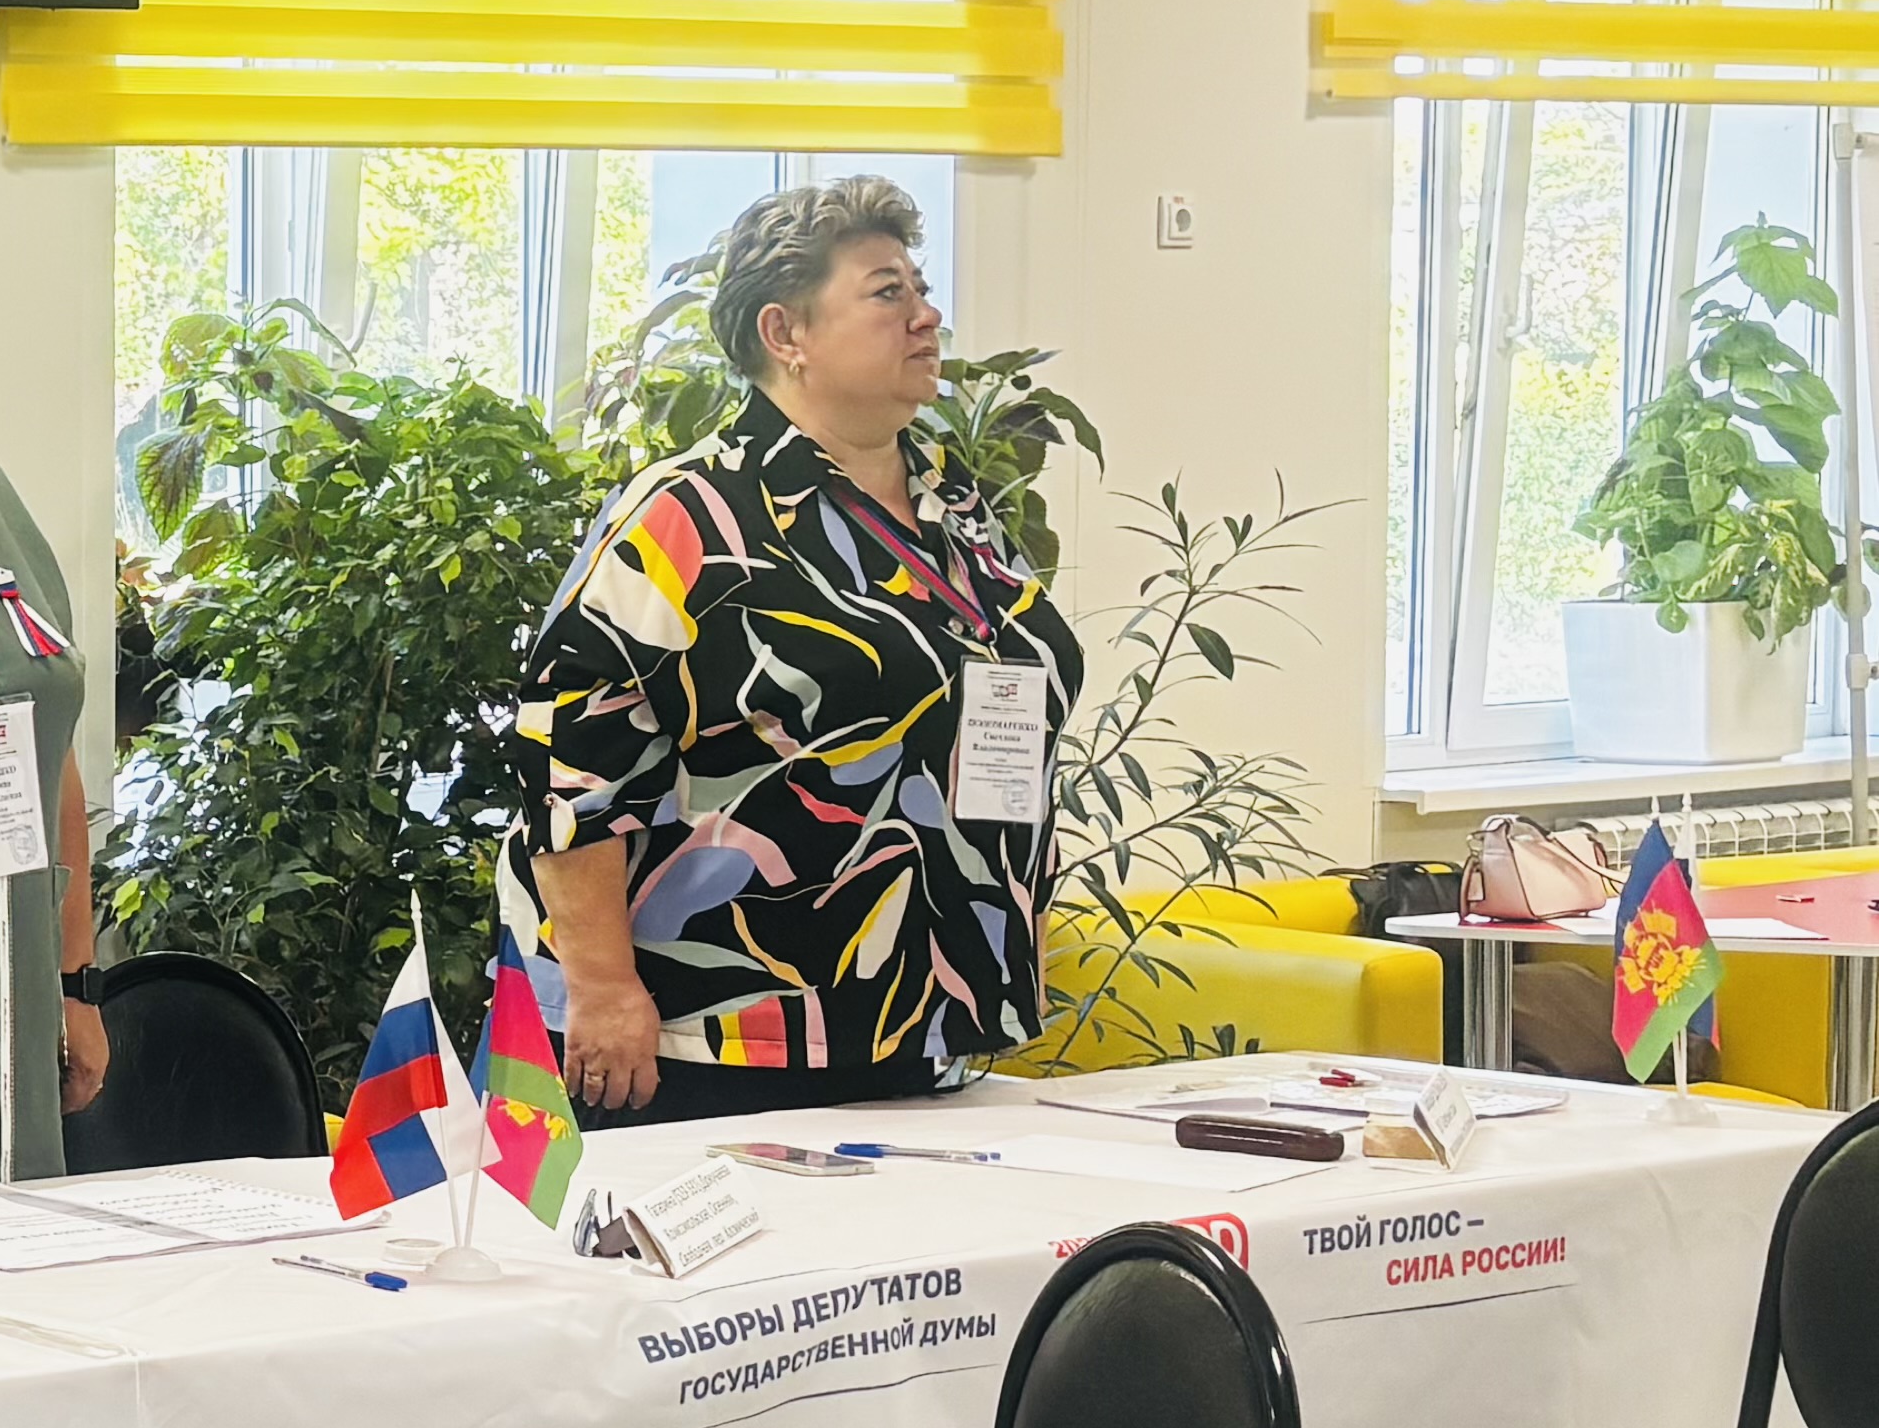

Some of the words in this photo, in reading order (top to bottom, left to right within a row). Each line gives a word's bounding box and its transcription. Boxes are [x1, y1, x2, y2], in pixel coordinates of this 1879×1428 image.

[1303, 1214, 1372, 1256] ТВОЙ
[1378, 1209, 1462, 1246] ГОЛОС
[1386, 1252, 1455, 1286] СИЛА
[1461, 1236, 1567, 1276] РОССИИ!
[638, 1303, 785, 1365] ВЫБОРЫ
[792, 1267, 963, 1332] ДЕПУТАТОВ
[679, 1316, 914, 1405] ГОСУДАРСТВЕННОЙ
[919, 1313, 997, 1348] ДУМЫ
